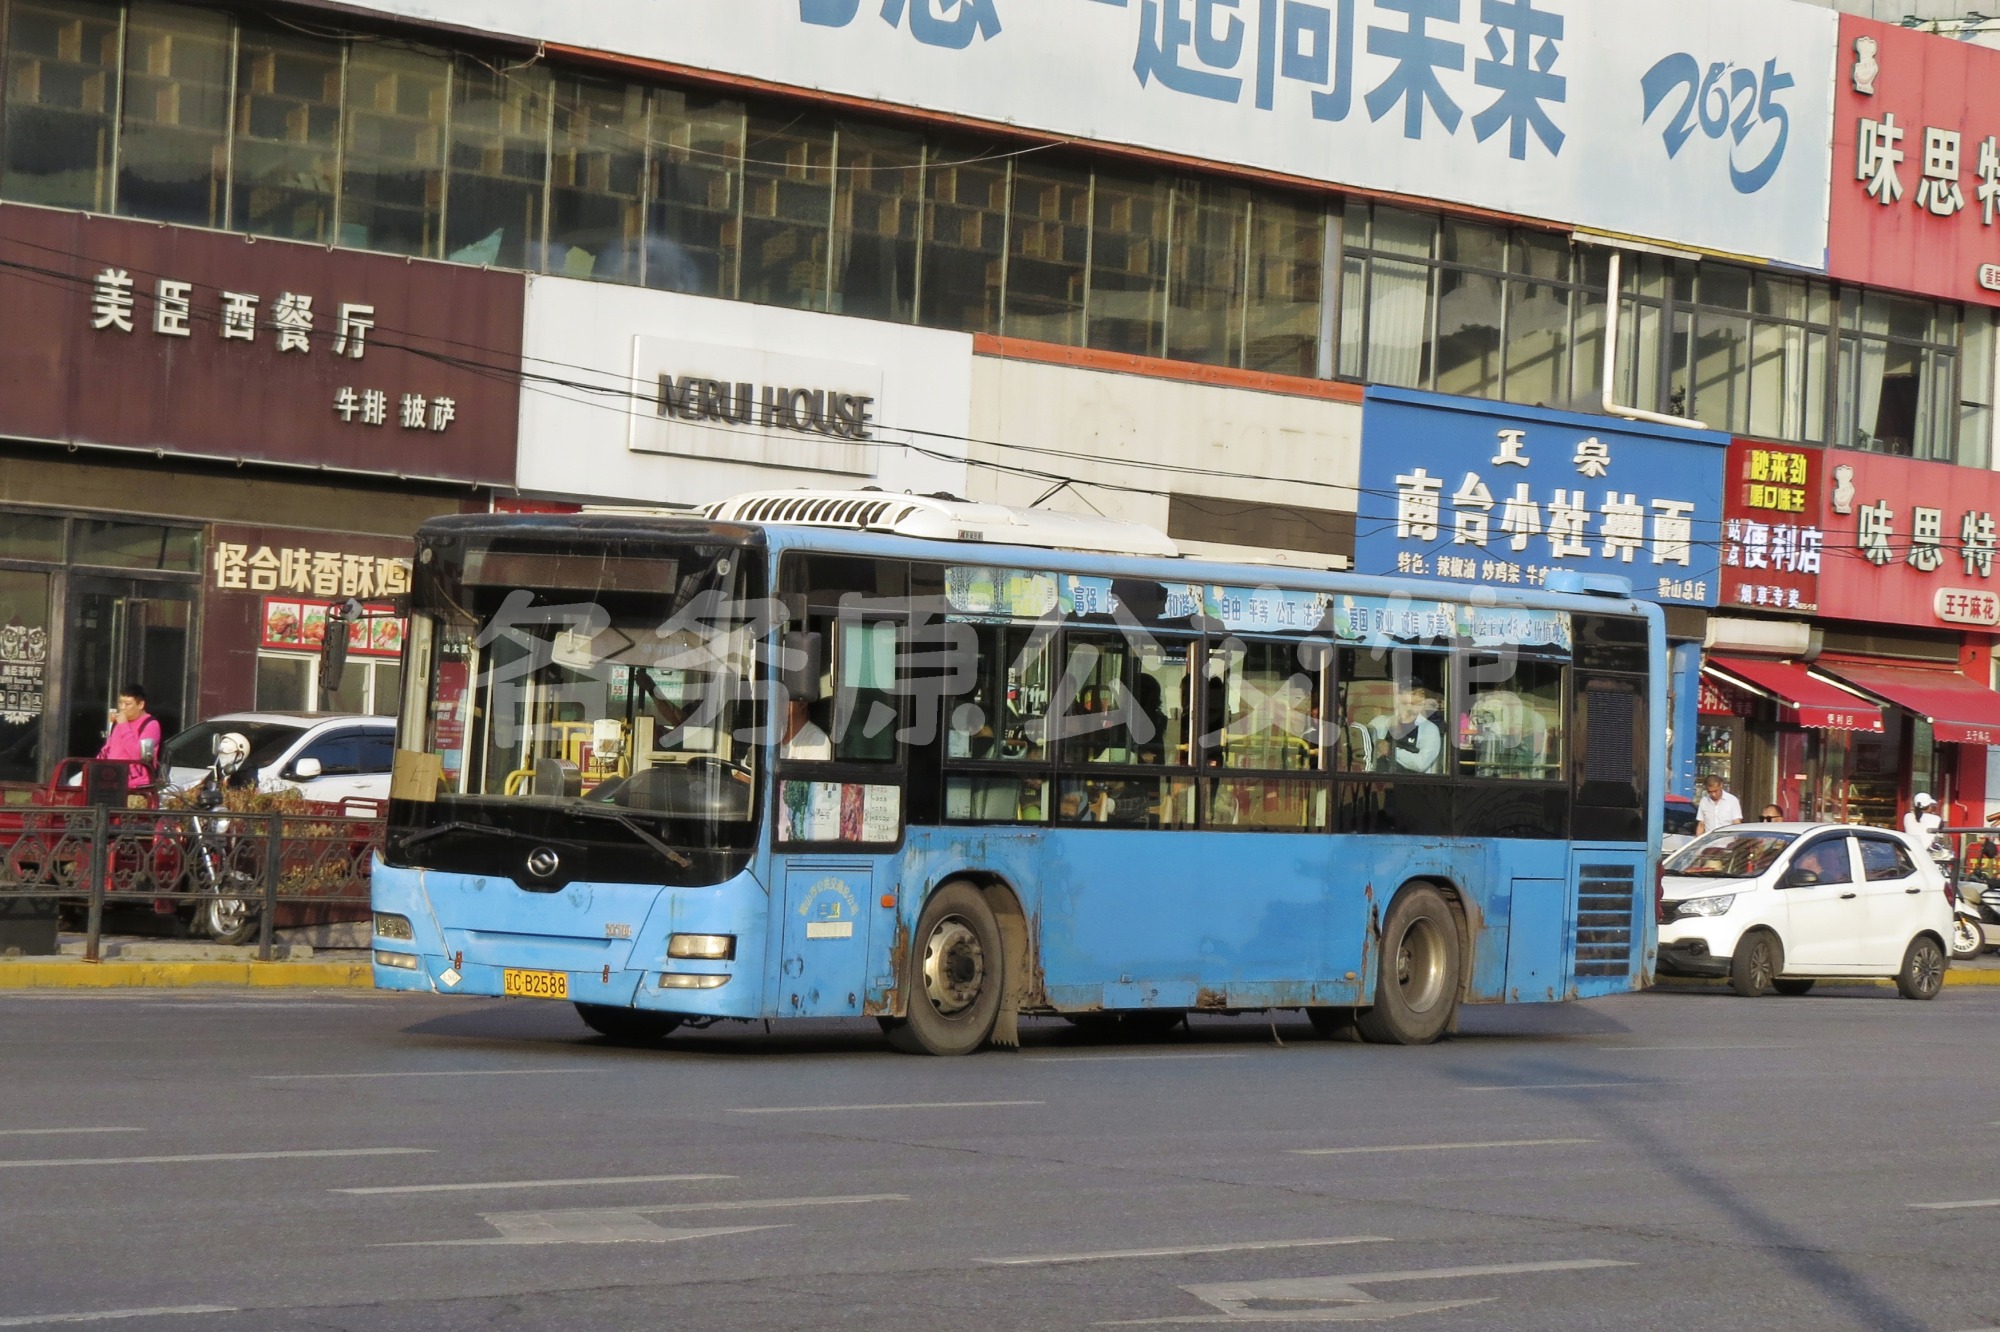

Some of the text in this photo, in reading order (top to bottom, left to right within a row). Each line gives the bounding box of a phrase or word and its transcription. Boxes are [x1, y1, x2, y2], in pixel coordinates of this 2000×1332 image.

[1640, 52, 1796, 195] 2025
[91, 267, 376, 361] 美臣西餐厅
[333, 385, 457, 434] 牛排 披萨
[761, 385, 874, 439] HOUSE
[1490, 428, 1611, 478] 正宗
[1743, 520, 1823, 575] 便利店
[1857, 499, 1998, 578] 味思特
[214, 541, 412, 598] 怪合味香酥鸡
[1437, 555, 1476, 580] 辣椒油
[1482, 560, 1520, 584] 炒鸡架
[1073, 586, 1098, 613] 富强
[1167, 593, 1191, 617] 和谐
[1220, 595, 1242, 622] 自由
[1248, 597, 1269, 625] 平等
[1275, 600, 1297, 627] 公正
[1740, 583, 1800, 609] 烟草专卖
[1944, 594, 1995, 620] 王子麻花
[1349, 606, 1447, 639] 爱国 敬业 诚信 友善
[1826, 713, 1853, 727] 便利店
[442, 973, 459, 983] LNG
